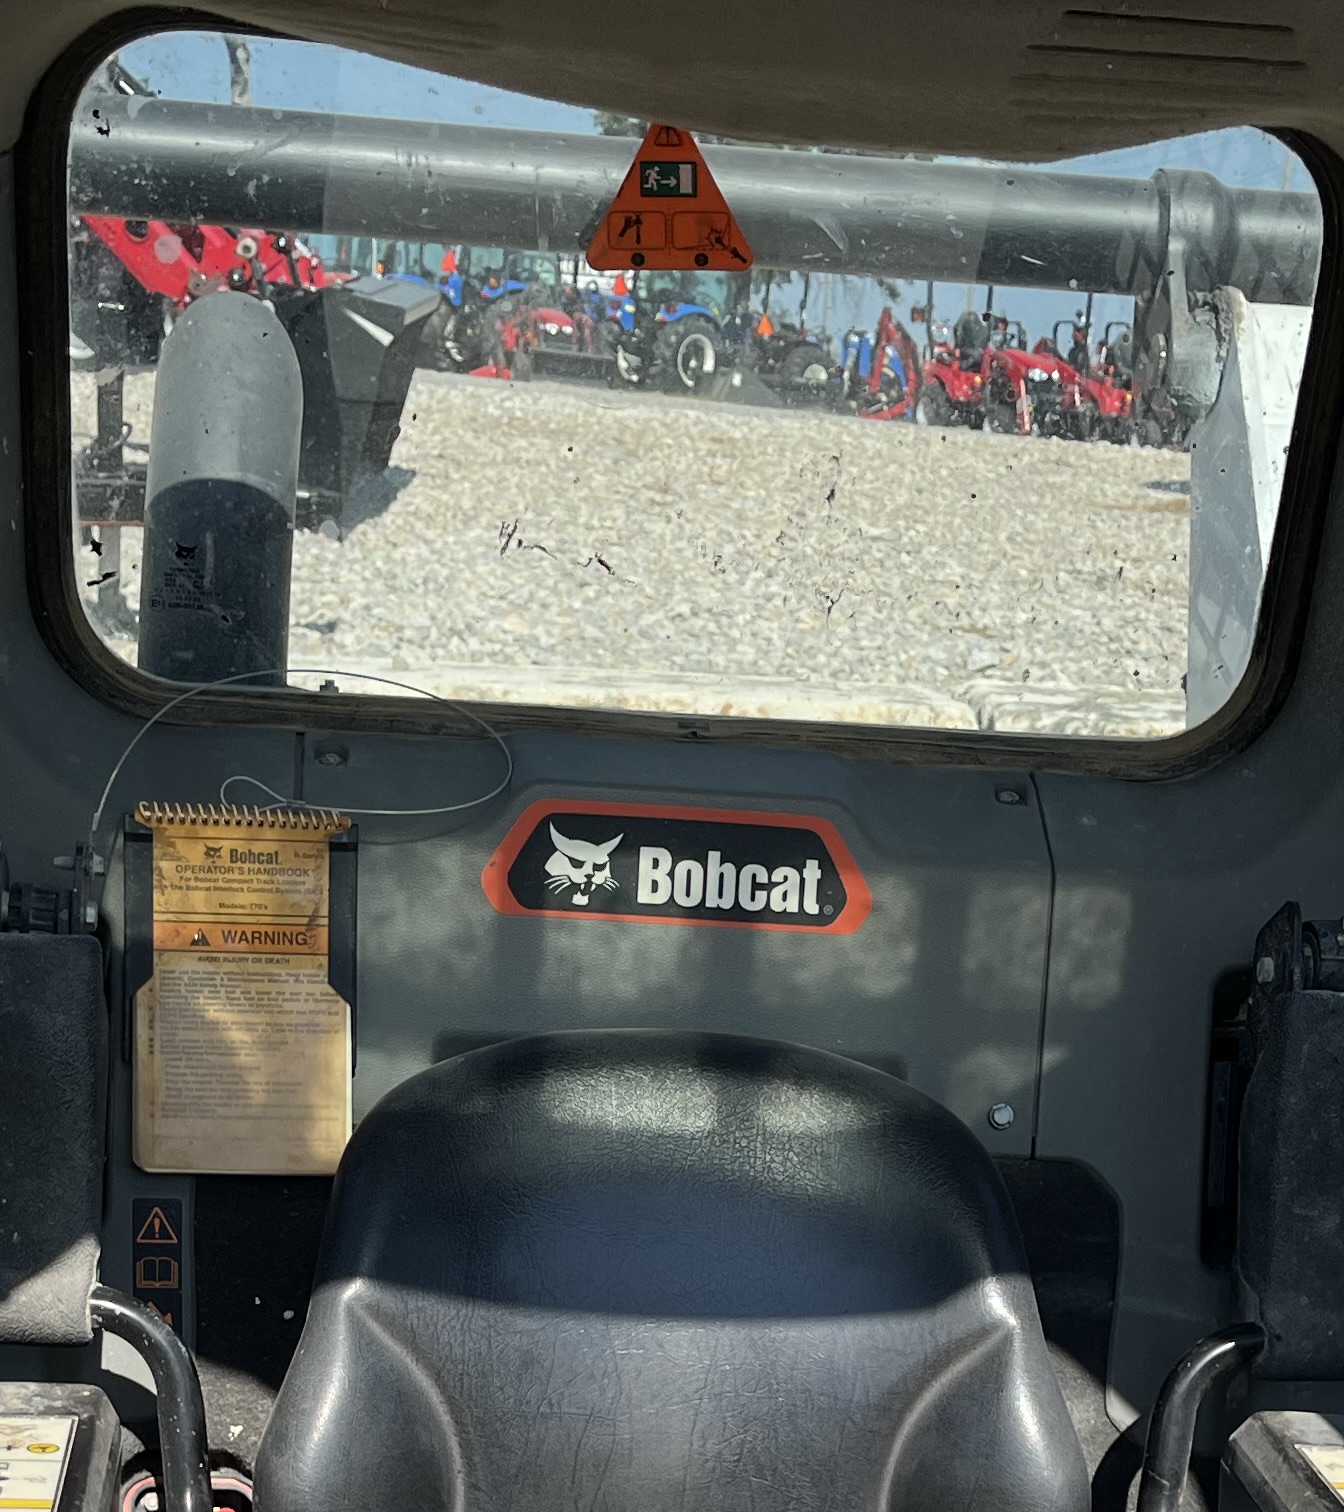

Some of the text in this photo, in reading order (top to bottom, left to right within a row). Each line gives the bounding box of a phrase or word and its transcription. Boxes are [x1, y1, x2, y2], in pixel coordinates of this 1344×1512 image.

[229, 848, 280, 865] Bobcat
[175, 865, 310, 877] OPERATOR'S HANDBOOK
[636, 845, 823, 915] Bobcat
[221, 929, 308, 946] WARNING
[265, 957, 290, 965] DEATH
